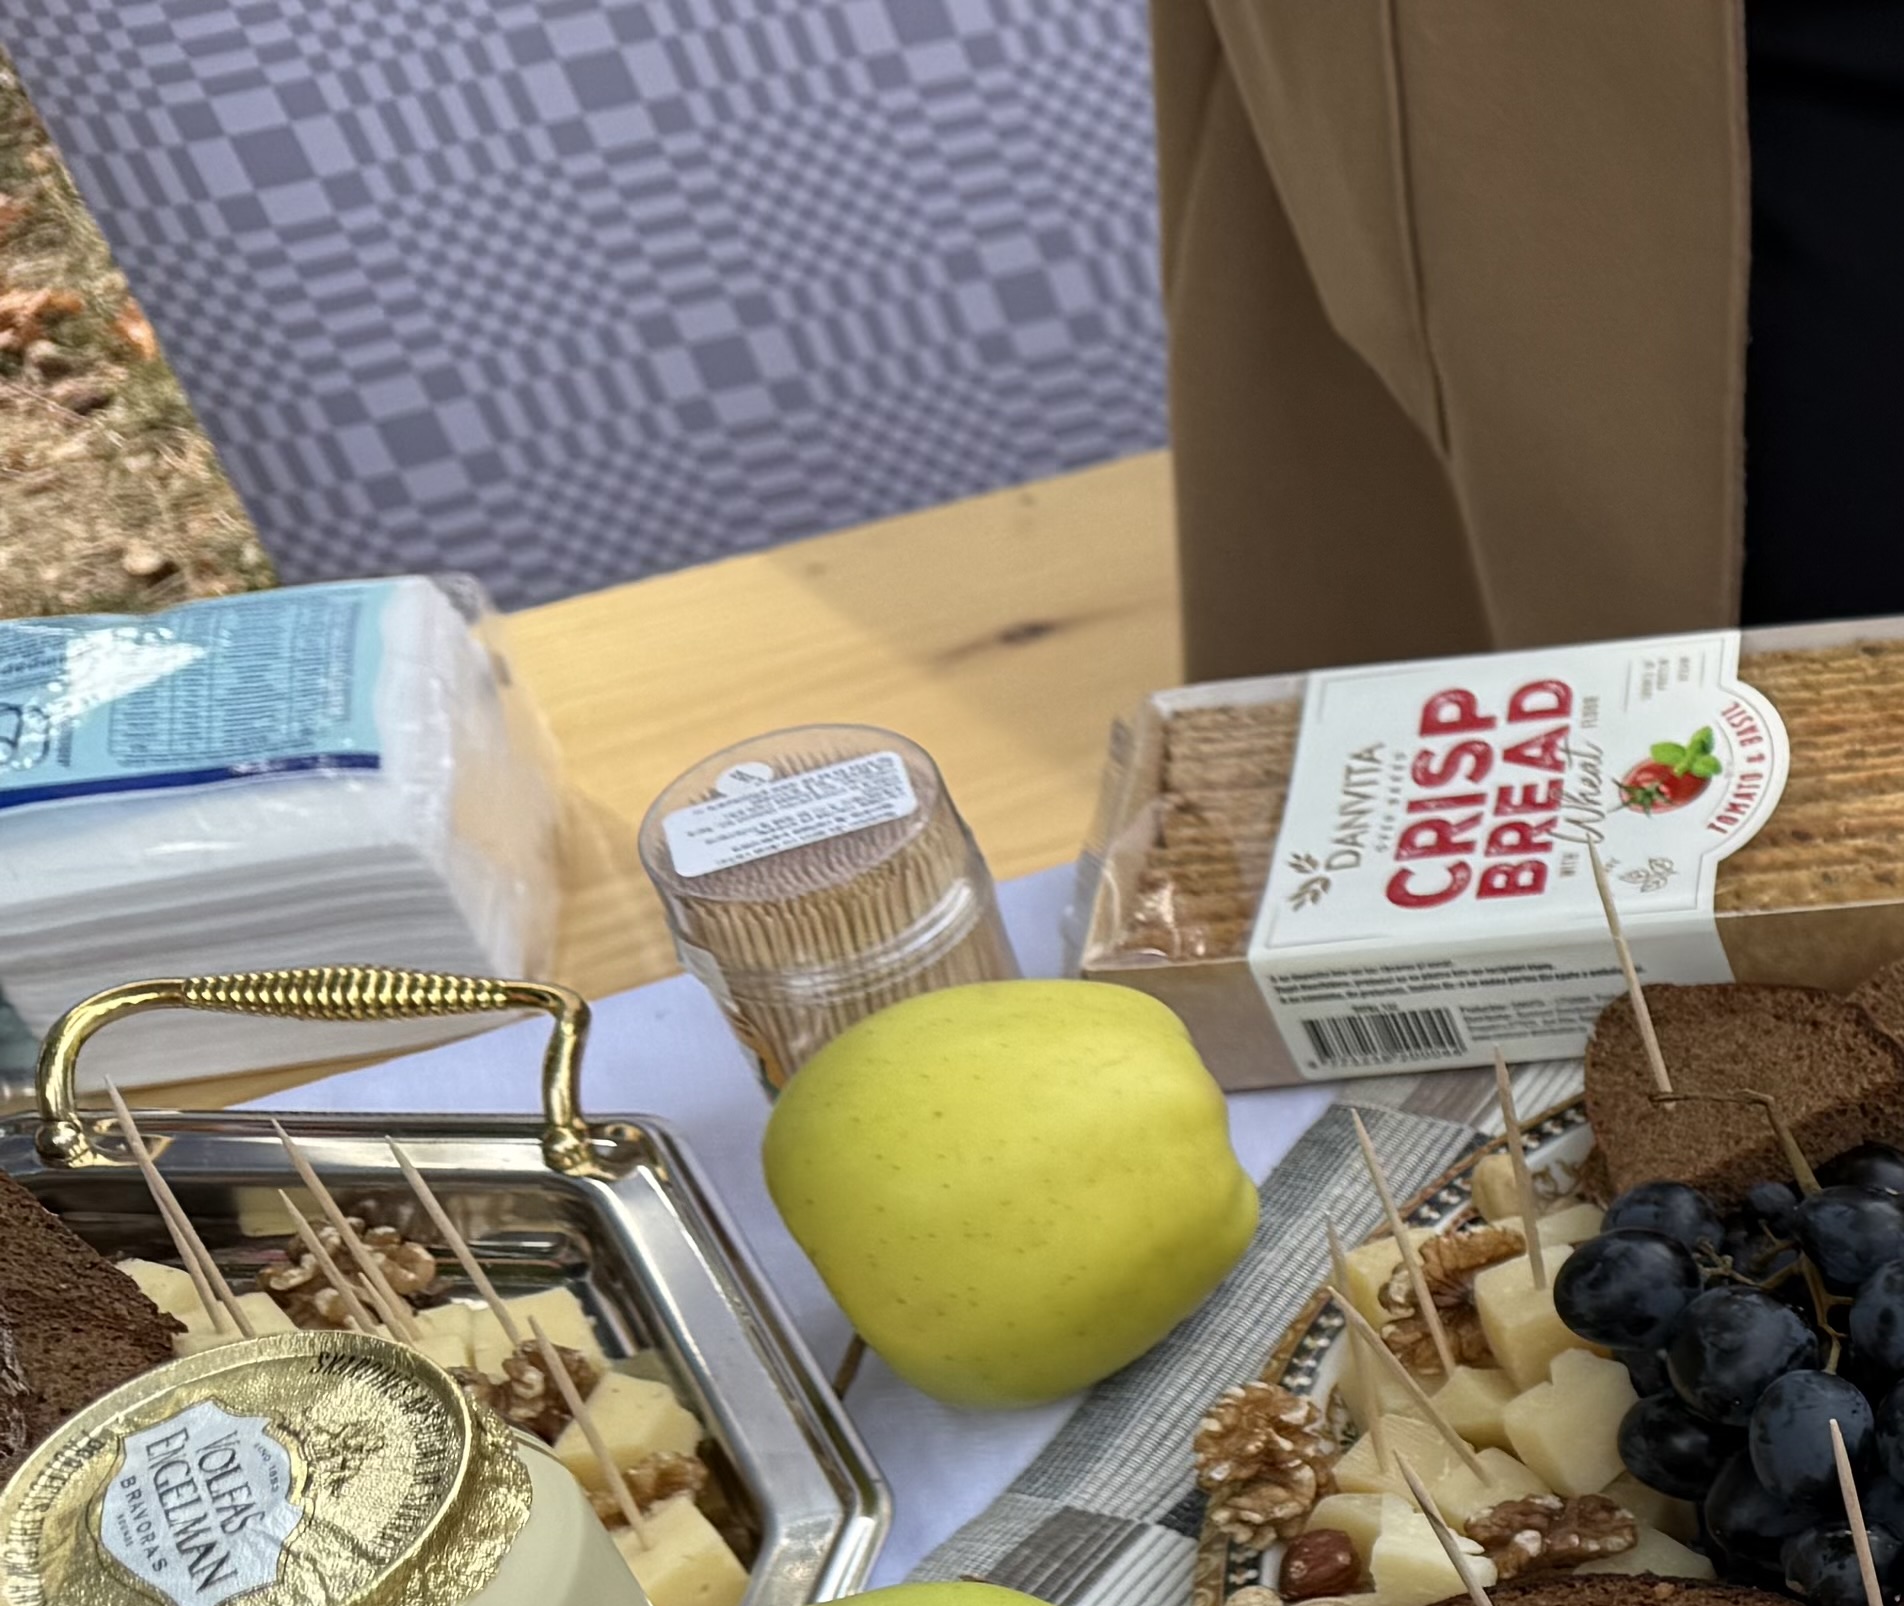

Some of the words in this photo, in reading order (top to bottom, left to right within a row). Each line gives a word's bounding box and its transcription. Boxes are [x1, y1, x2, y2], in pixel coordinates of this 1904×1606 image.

[1324, 741, 1386, 873] DANVITA
[1385, 684, 1500, 910] CRISP
[1475, 677, 1574, 902] BREAD
[1551, 734, 1603, 847] Wheat
[1707, 764, 1763, 836] TOMATO
[117, 1473, 170, 1576] BRAVORAS
[143, 1426, 240, 1596] ENGELMAN
[194, 1428, 268, 1539] VOLFAS
